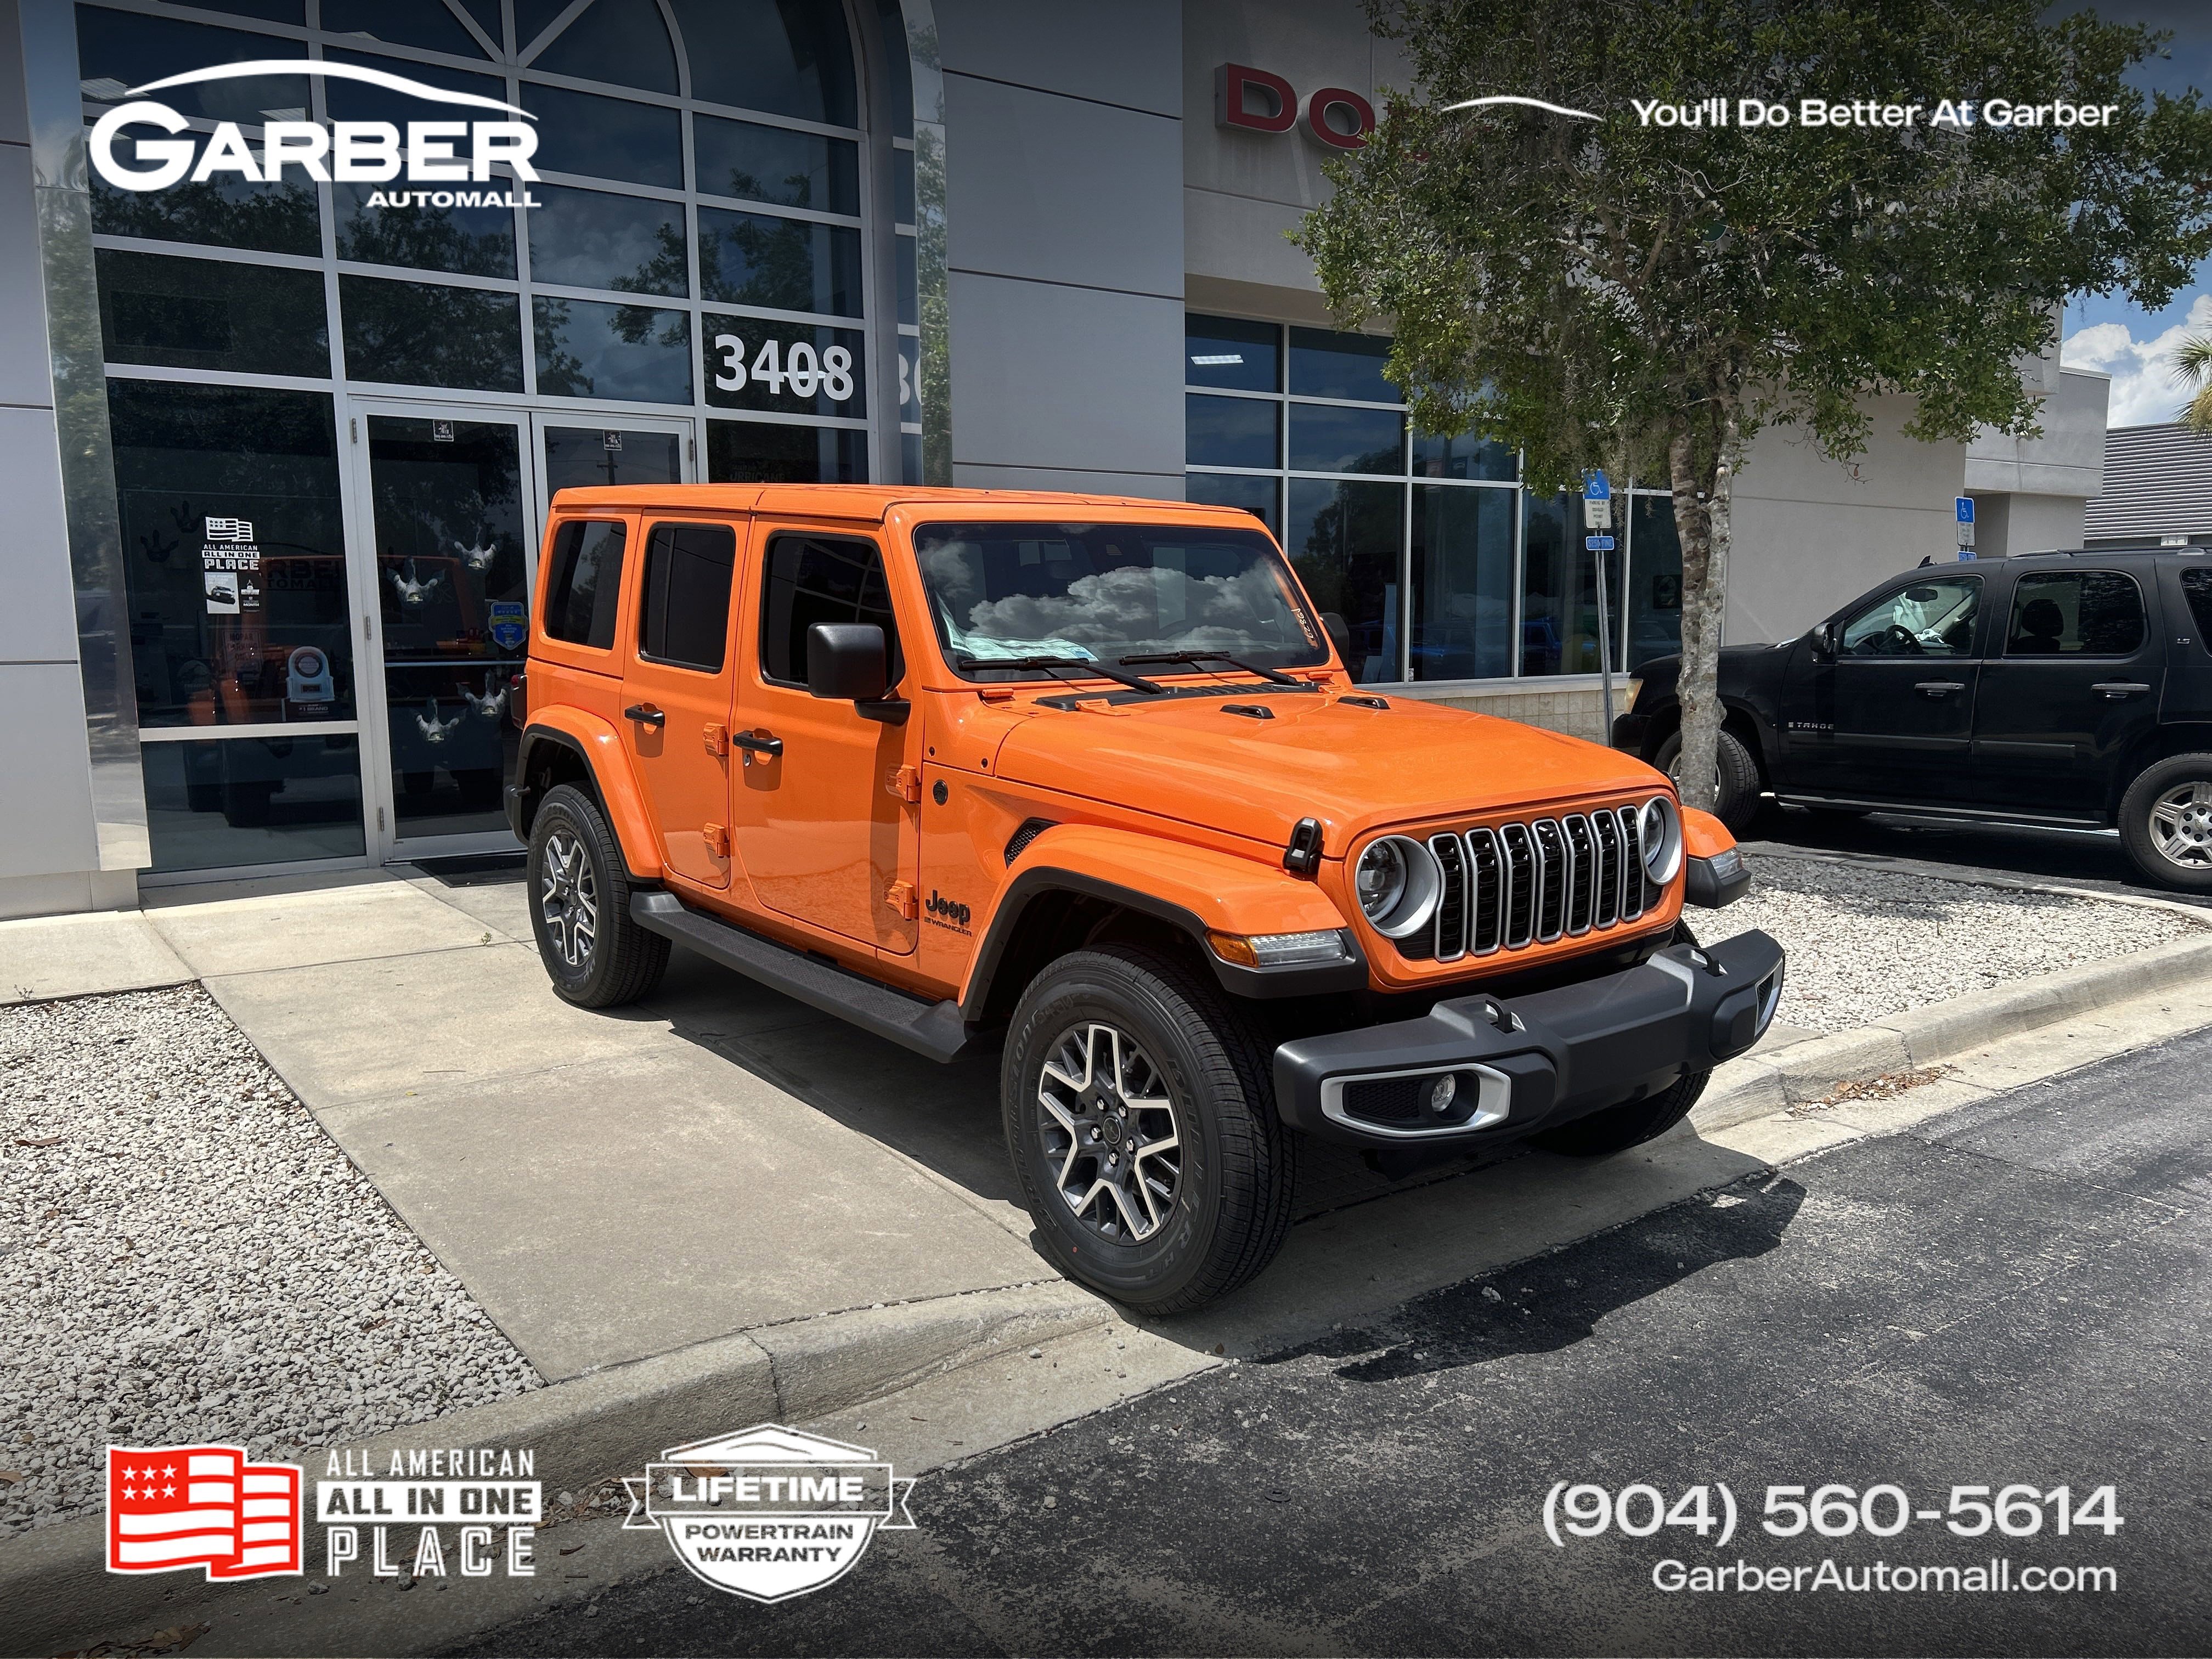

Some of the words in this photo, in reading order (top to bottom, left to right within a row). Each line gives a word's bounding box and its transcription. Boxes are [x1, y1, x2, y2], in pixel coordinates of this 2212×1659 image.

[714, 334, 854, 401] 3408
[204, 559, 259, 571] PLACE
[925, 889, 970, 926] Jeep
[931, 918, 972, 937] WRANGLER
